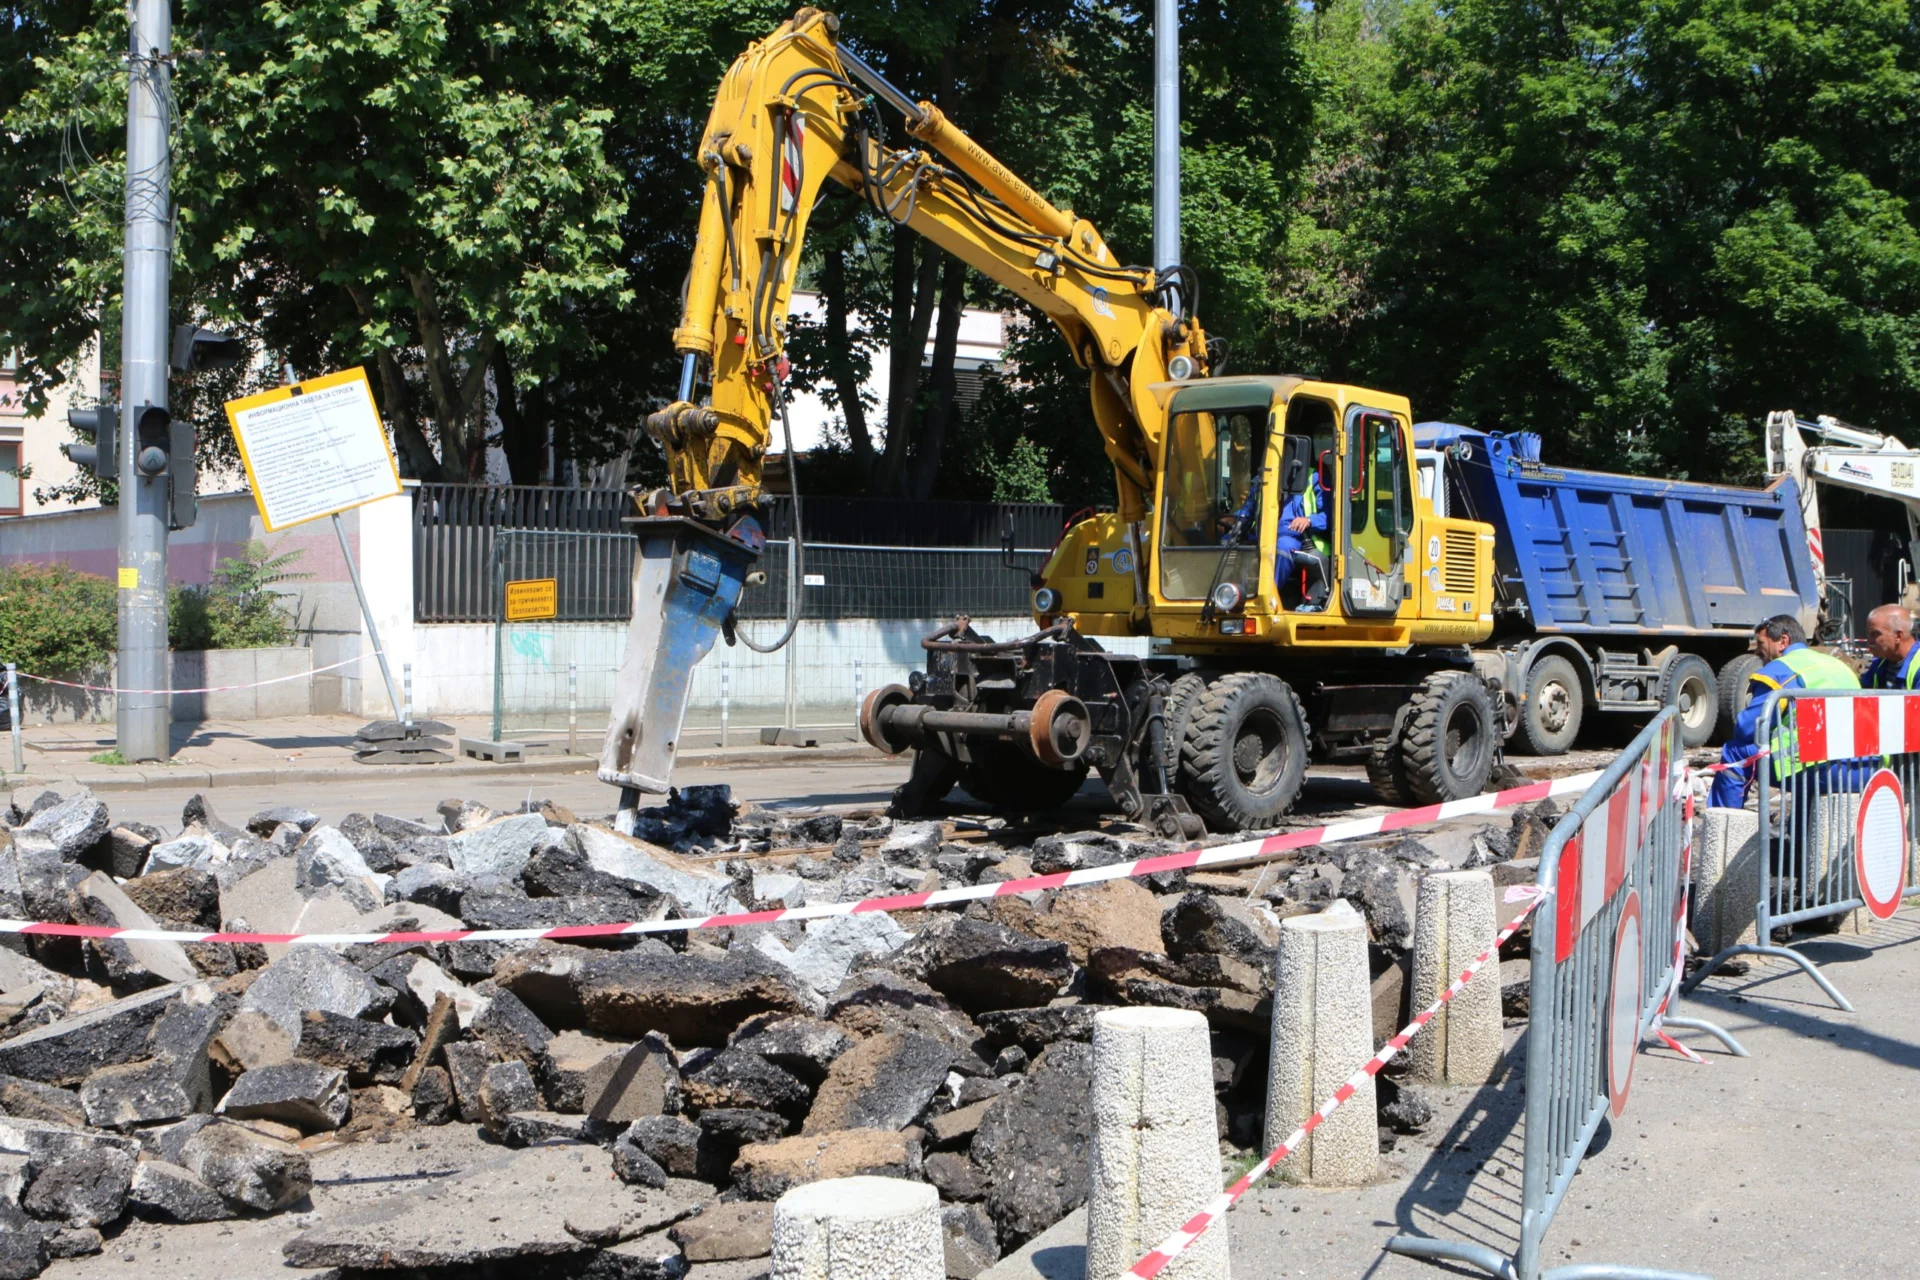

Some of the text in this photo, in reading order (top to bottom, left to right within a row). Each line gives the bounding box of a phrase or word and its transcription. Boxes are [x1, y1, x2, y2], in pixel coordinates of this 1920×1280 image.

[968, 141, 1045, 210] www.avis-eng.eu
[247, 400, 299, 419] ИНФОРМАЦИОННА
[299, 394, 322, 405] ТАБЕЛА
[331, 385, 354, 396] СТРОЕЖ
[1430, 541, 1439, 557] 20
[510, 586, 543, 595] Извиняваме
[518, 597, 553, 605] причиненото
[1424, 624, 1475, 636] www.avis-eng.eu
